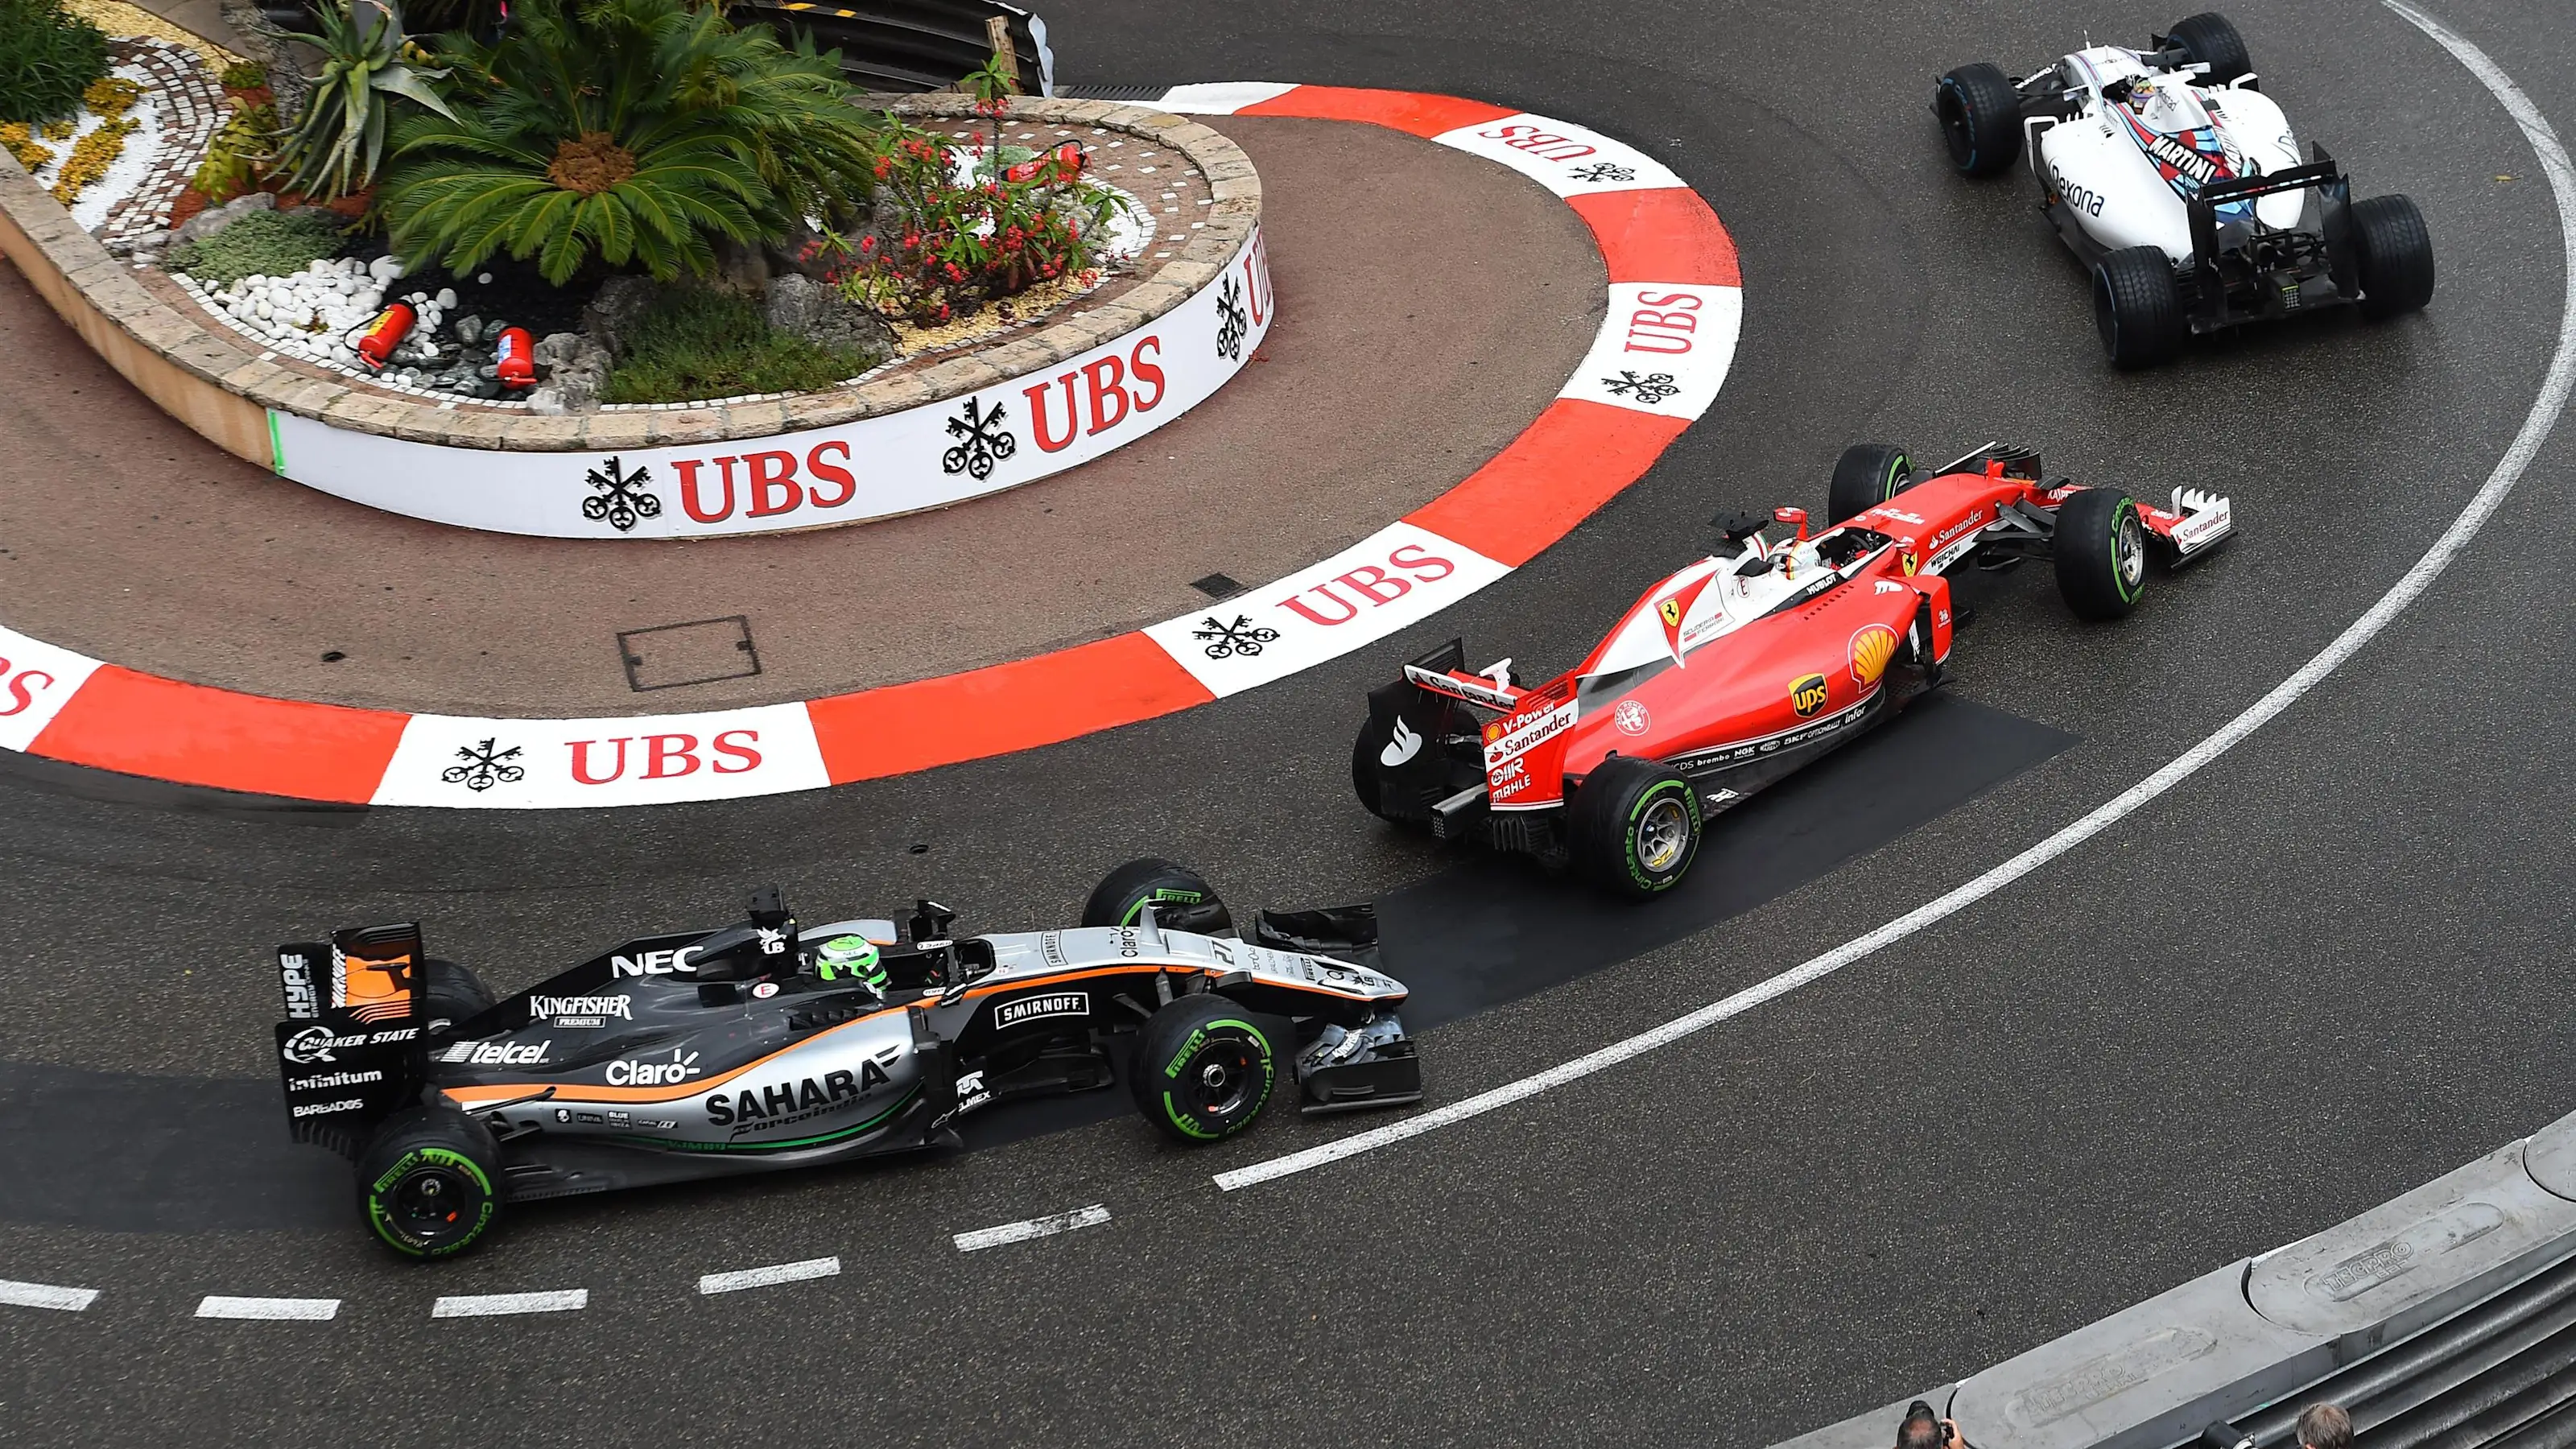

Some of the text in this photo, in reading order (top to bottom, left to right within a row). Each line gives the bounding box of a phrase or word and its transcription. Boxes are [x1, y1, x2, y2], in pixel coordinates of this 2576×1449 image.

[1478, 124, 1598, 163] UBS
[2148, 134, 2216, 185] MARTINI
[1624, 291, 1703, 356] UBS
[1023, 335, 1166, 453] UBS
[671, 440, 857, 524] UBS
[1938, 510, 1983, 544] Santander
[2183, 510, 2229, 542] Santander
[1931, 543, 1960, 568] WEICHAI
[1275, 544, 1455, 625] UBS
[1740, 578, 1748, 596] E
[1806, 573, 1837, 596] HUBLOT
[1794, 683, 1827, 715] ups
[1503, 702, 1555, 734] V-Power
[1845, 706, 1866, 724] infor
[1505, 712, 1571, 756] Santander
[564, 729, 763, 786] UBS
[1697, 753, 1730, 766] brembo
[1734, 745, 1755, 758] NGK
[1492, 774, 1531, 803] MAHLE
[1044, 934, 1062, 964] SMIRNOFF
[1121, 929, 1138, 958] Claro
[1212, 940, 1235, 965] 27
[611, 946, 704, 979] NEC
[280, 954, 311, 1019] HYPE
[308, 985, 320, 1018] ENERGY
[761, 985, 771, 996] E
[529, 994, 634, 1021] KINGFISHER
[559, 1018, 601, 1026] PREMIUM
[1004, 997, 1080, 1021] SMIRNOFF
[298, 1028, 420, 1051] QUAKER STATE
[470, 1040, 551, 1064] telcel
[288, 1070, 383, 1092] infinitum
[606, 1059, 686, 1086] Claro
[706, 1056, 891, 1128] SAHARA
[293, 1098, 364, 1117] BARBADOS
[2322, 1241, 2413, 1291] TECPRO
